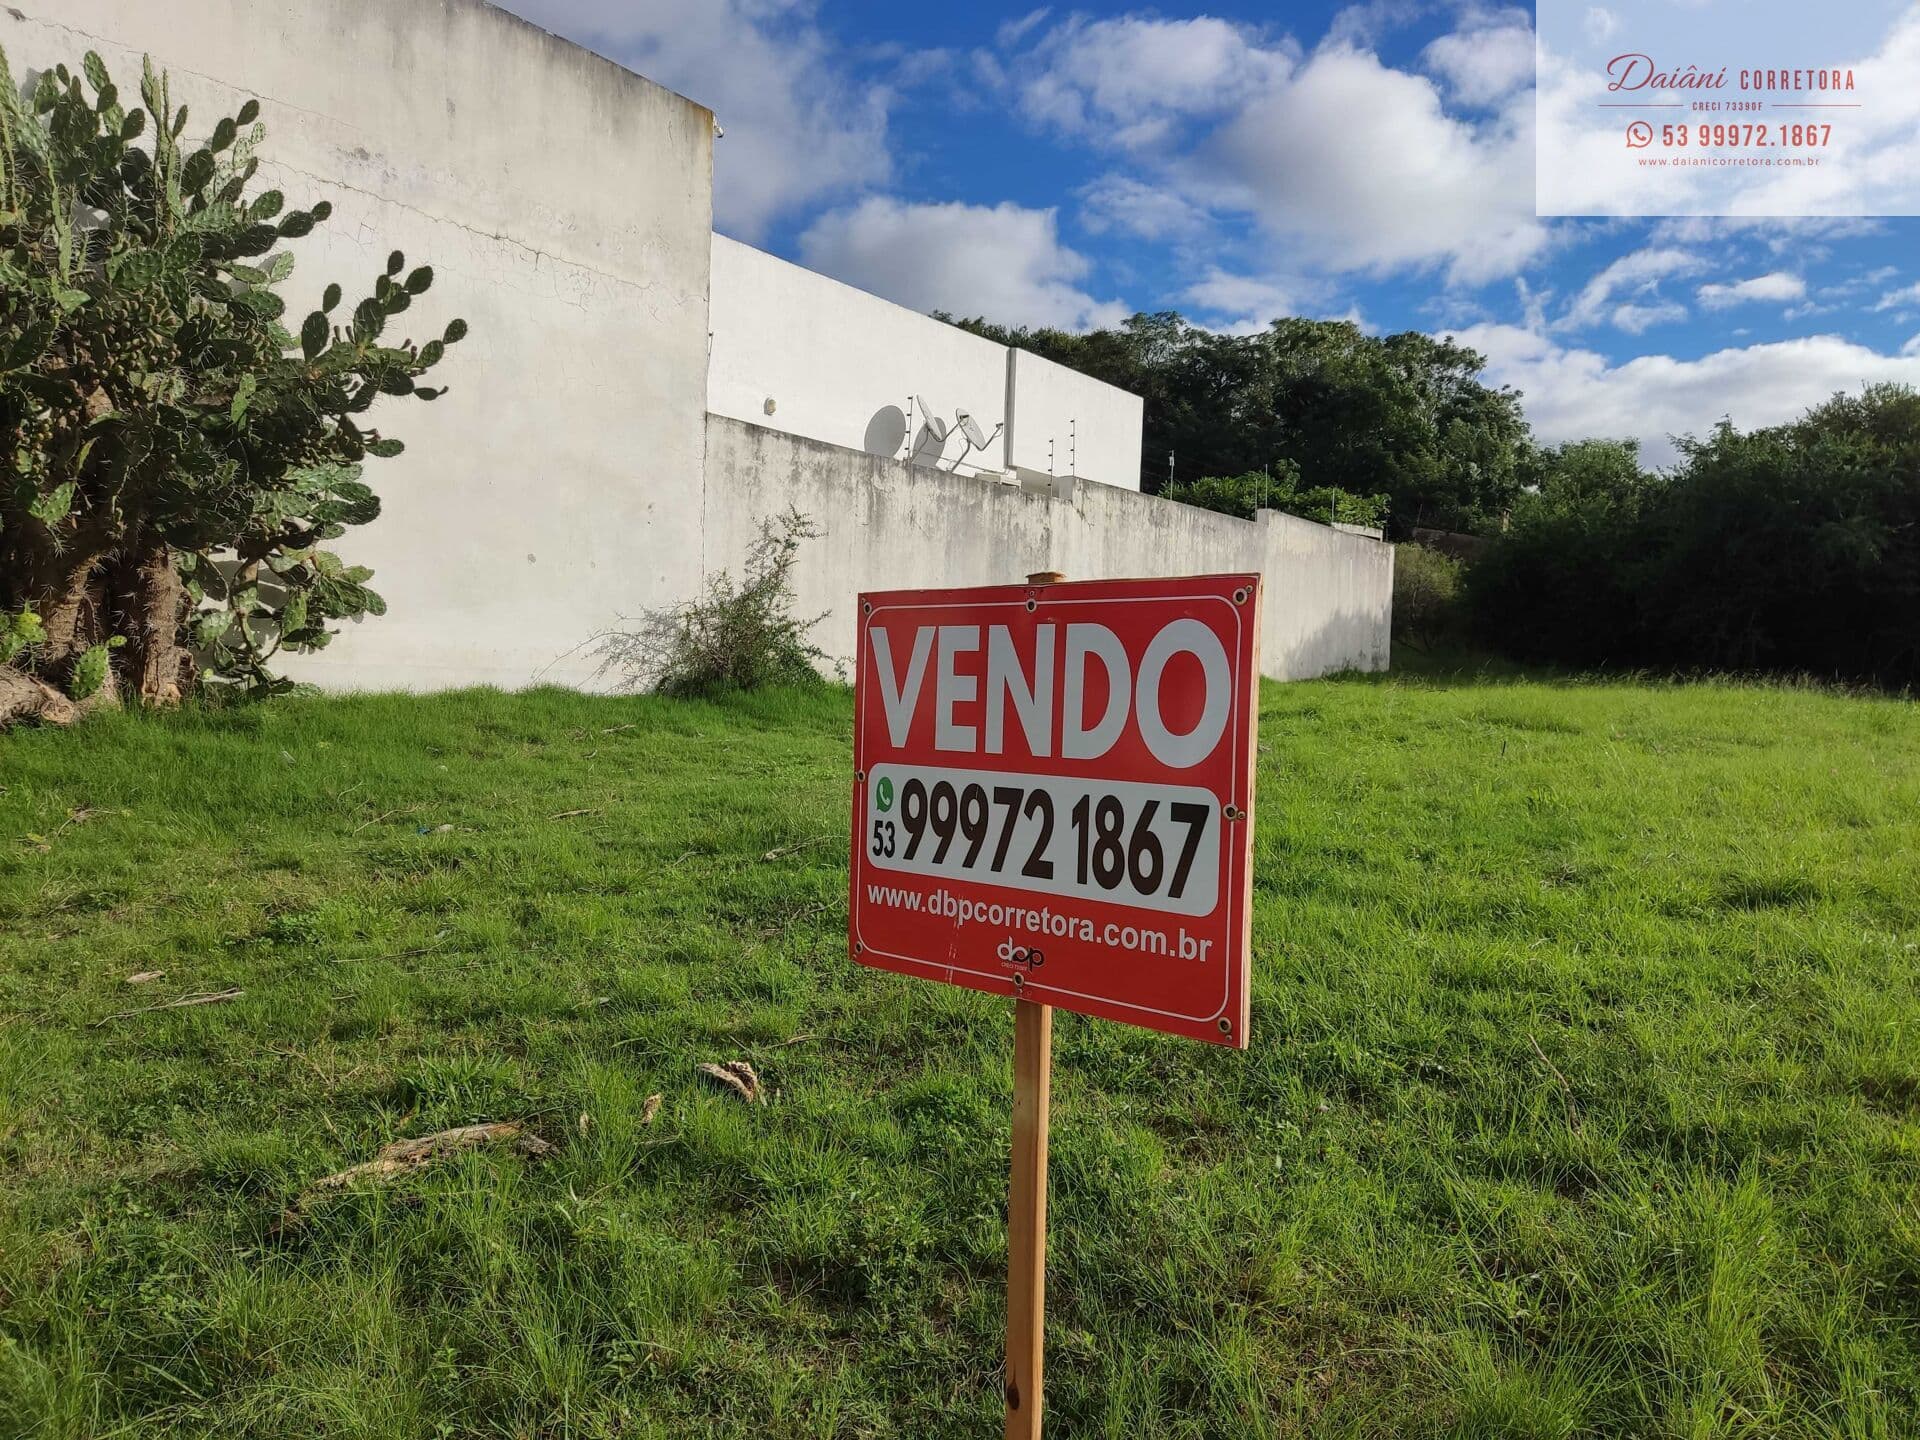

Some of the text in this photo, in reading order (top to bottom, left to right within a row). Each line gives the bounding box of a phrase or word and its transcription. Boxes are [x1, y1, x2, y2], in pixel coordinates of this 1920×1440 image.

[869, 619, 1232, 768] VENDO
[872, 819, 896, 859] 53
[900, 777, 1210, 899] 99972 1867
[867, 881, 1213, 962] www.dbpcorretora.com.br
